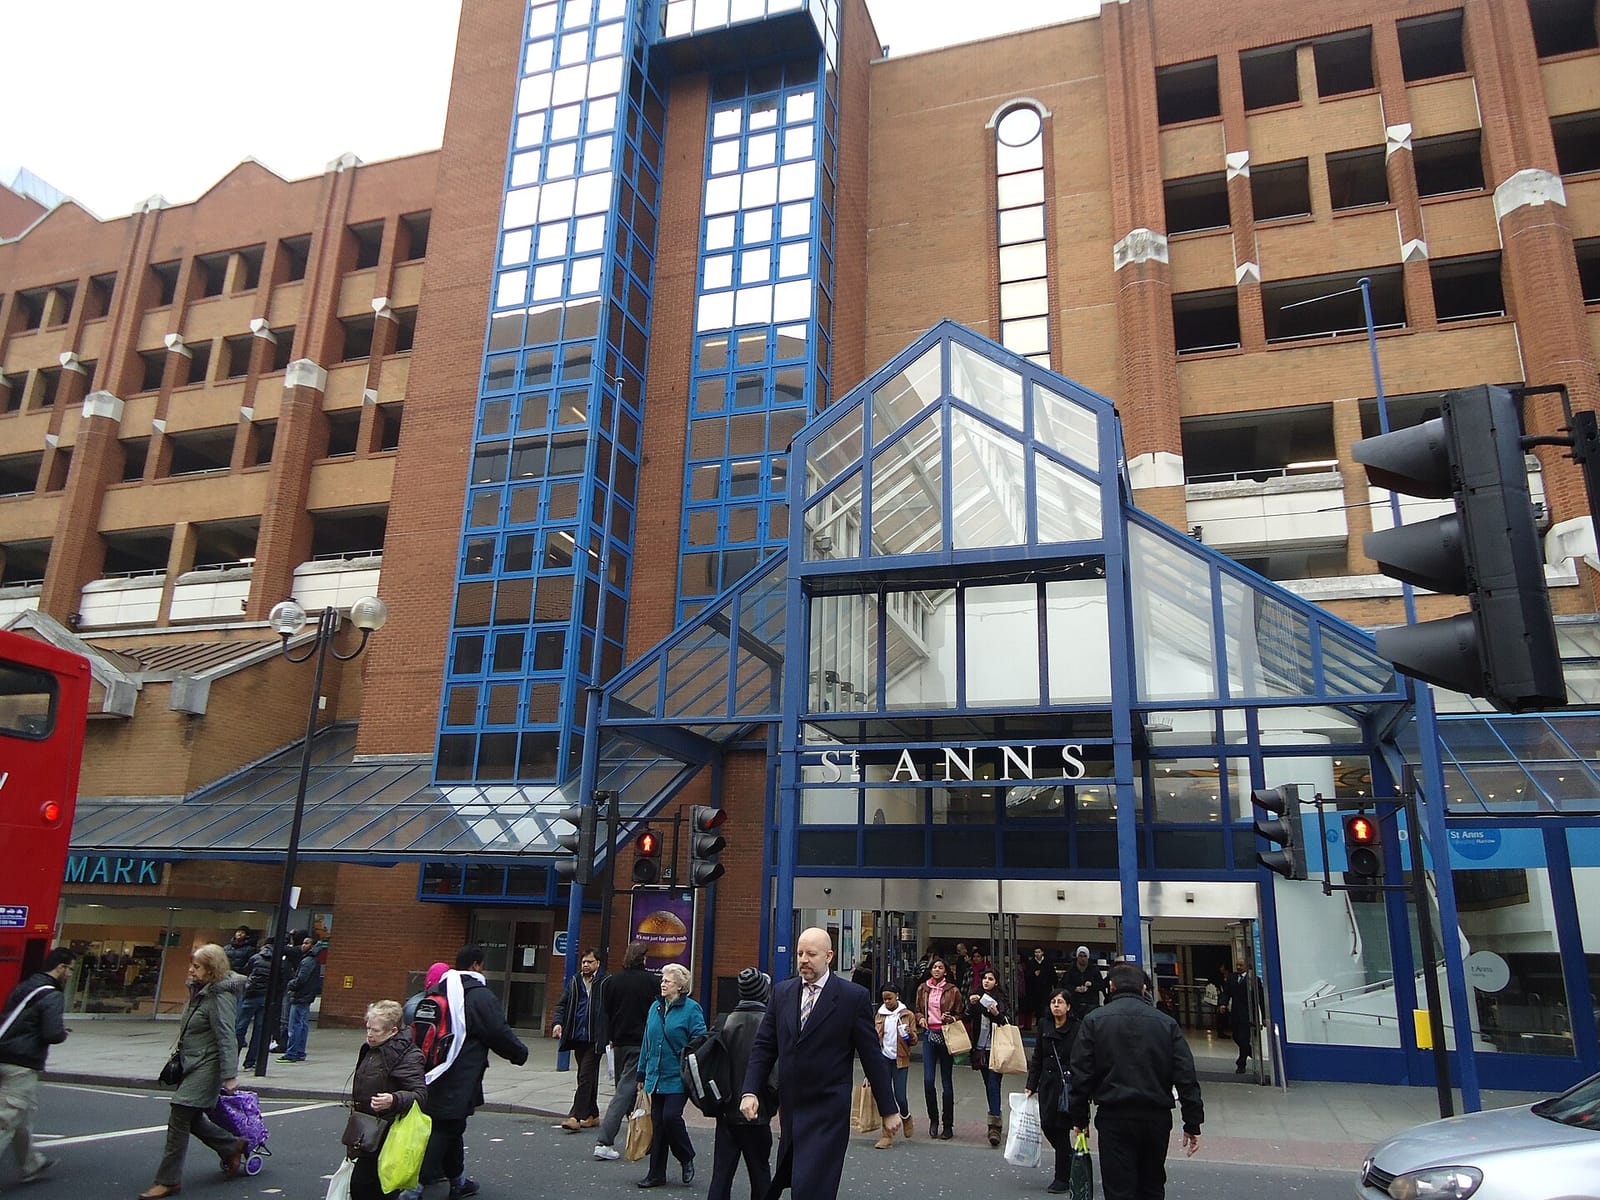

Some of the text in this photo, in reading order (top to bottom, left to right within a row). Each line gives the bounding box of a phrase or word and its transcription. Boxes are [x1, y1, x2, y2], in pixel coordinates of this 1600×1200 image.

[821, 744, 1087, 784] St ANNS
[1450, 831, 1485, 839] St Anns
[64, 855, 157, 884] MARK
